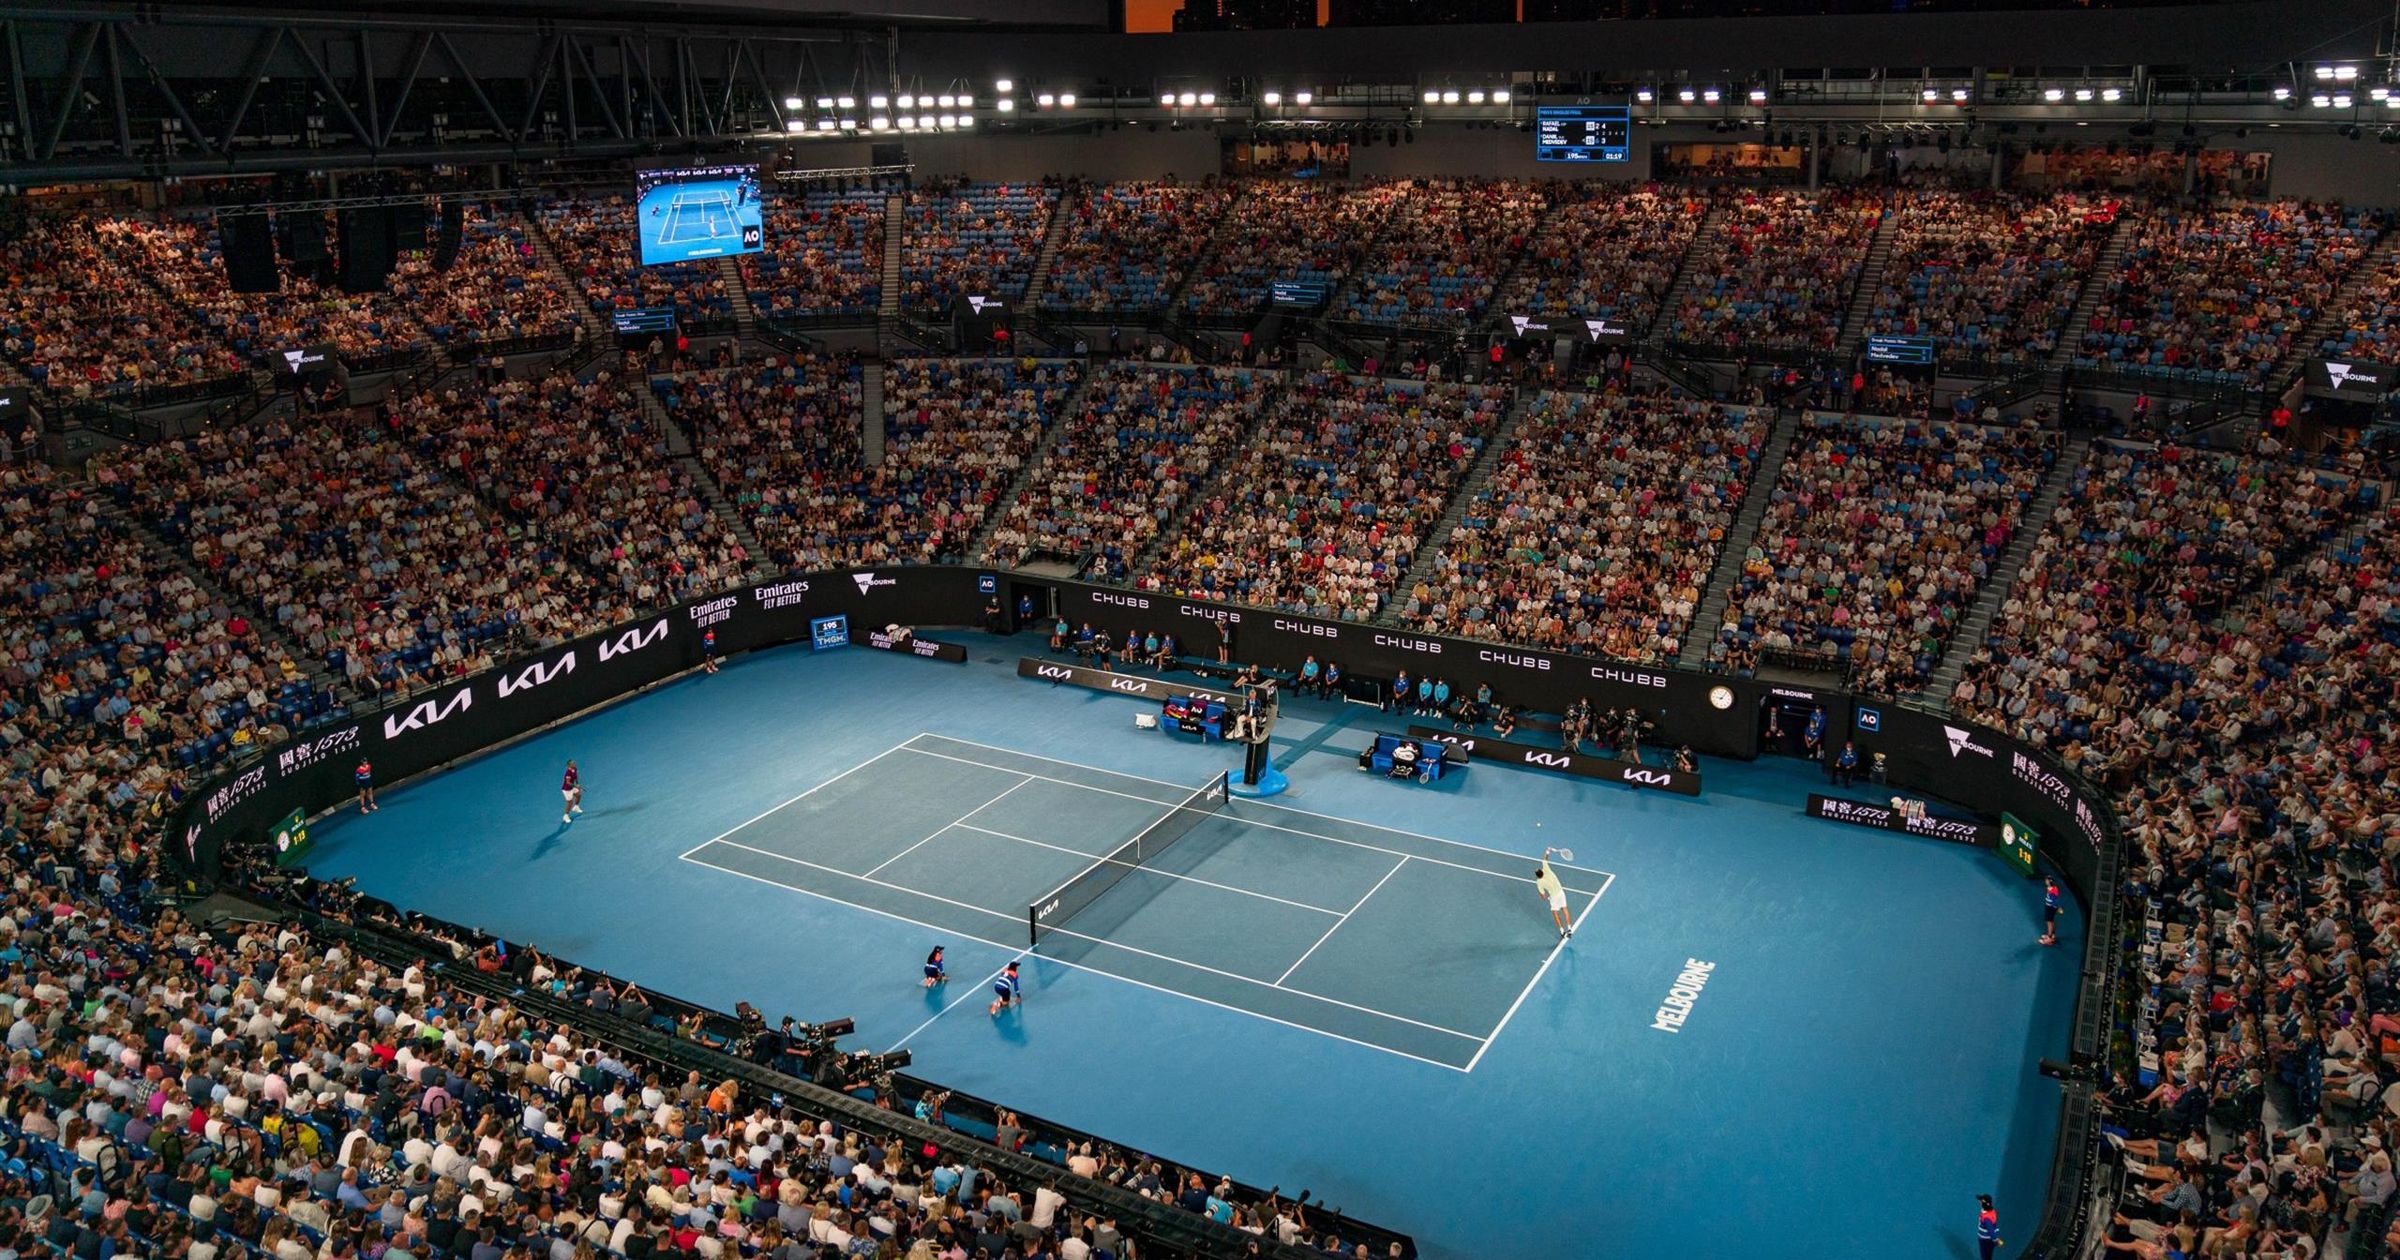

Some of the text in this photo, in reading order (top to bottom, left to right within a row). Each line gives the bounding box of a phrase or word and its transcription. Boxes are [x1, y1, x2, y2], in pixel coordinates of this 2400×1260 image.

[744, 230, 759, 243] AO
[755, 580, 809, 601] Emirates
[981, 580, 993, 588] AO
[690, 595, 738, 620] Emirates
[763, 593, 801, 610] FLY BETTER
[1092, 592, 1150, 609] CHUBB
[697, 608, 731, 629] FLY BETTER
[1181, 605, 1241, 623] CHUBB
[823, 621, 837, 630] 195
[1274, 619, 1338, 638] CHUBB
[599, 618, 669, 662] KIA
[912, 639, 940, 651] Emirates
[1374, 635, 1442, 654] CHUBB
[1479, 650, 1551, 670] CHUBB
[498, 651, 576, 699] KIA
[1037, 664, 1073, 680] KIA
[1111, 677, 1147, 693] KIA
[1591, 667, 1667, 688] CHUBB
[1772, 688, 1813, 700] MELBOURNE
[384, 687, 472, 740] KIA
[1861, 713, 1877, 725] AO
[281, 740, 360, 777] GUOJIAO 1573
[1524, 750, 1570, 768] KIA
[1623, 767, 1671, 786] KIA
[1206, 783, 1223, 801] KIA
[1821, 810, 1862, 823] GUOJIAO
[1906, 826, 1947, 838] GUOJIAO
[1038, 899, 1059, 920] KIA
[1650, 957, 1717, 1034] MELBOURNE
